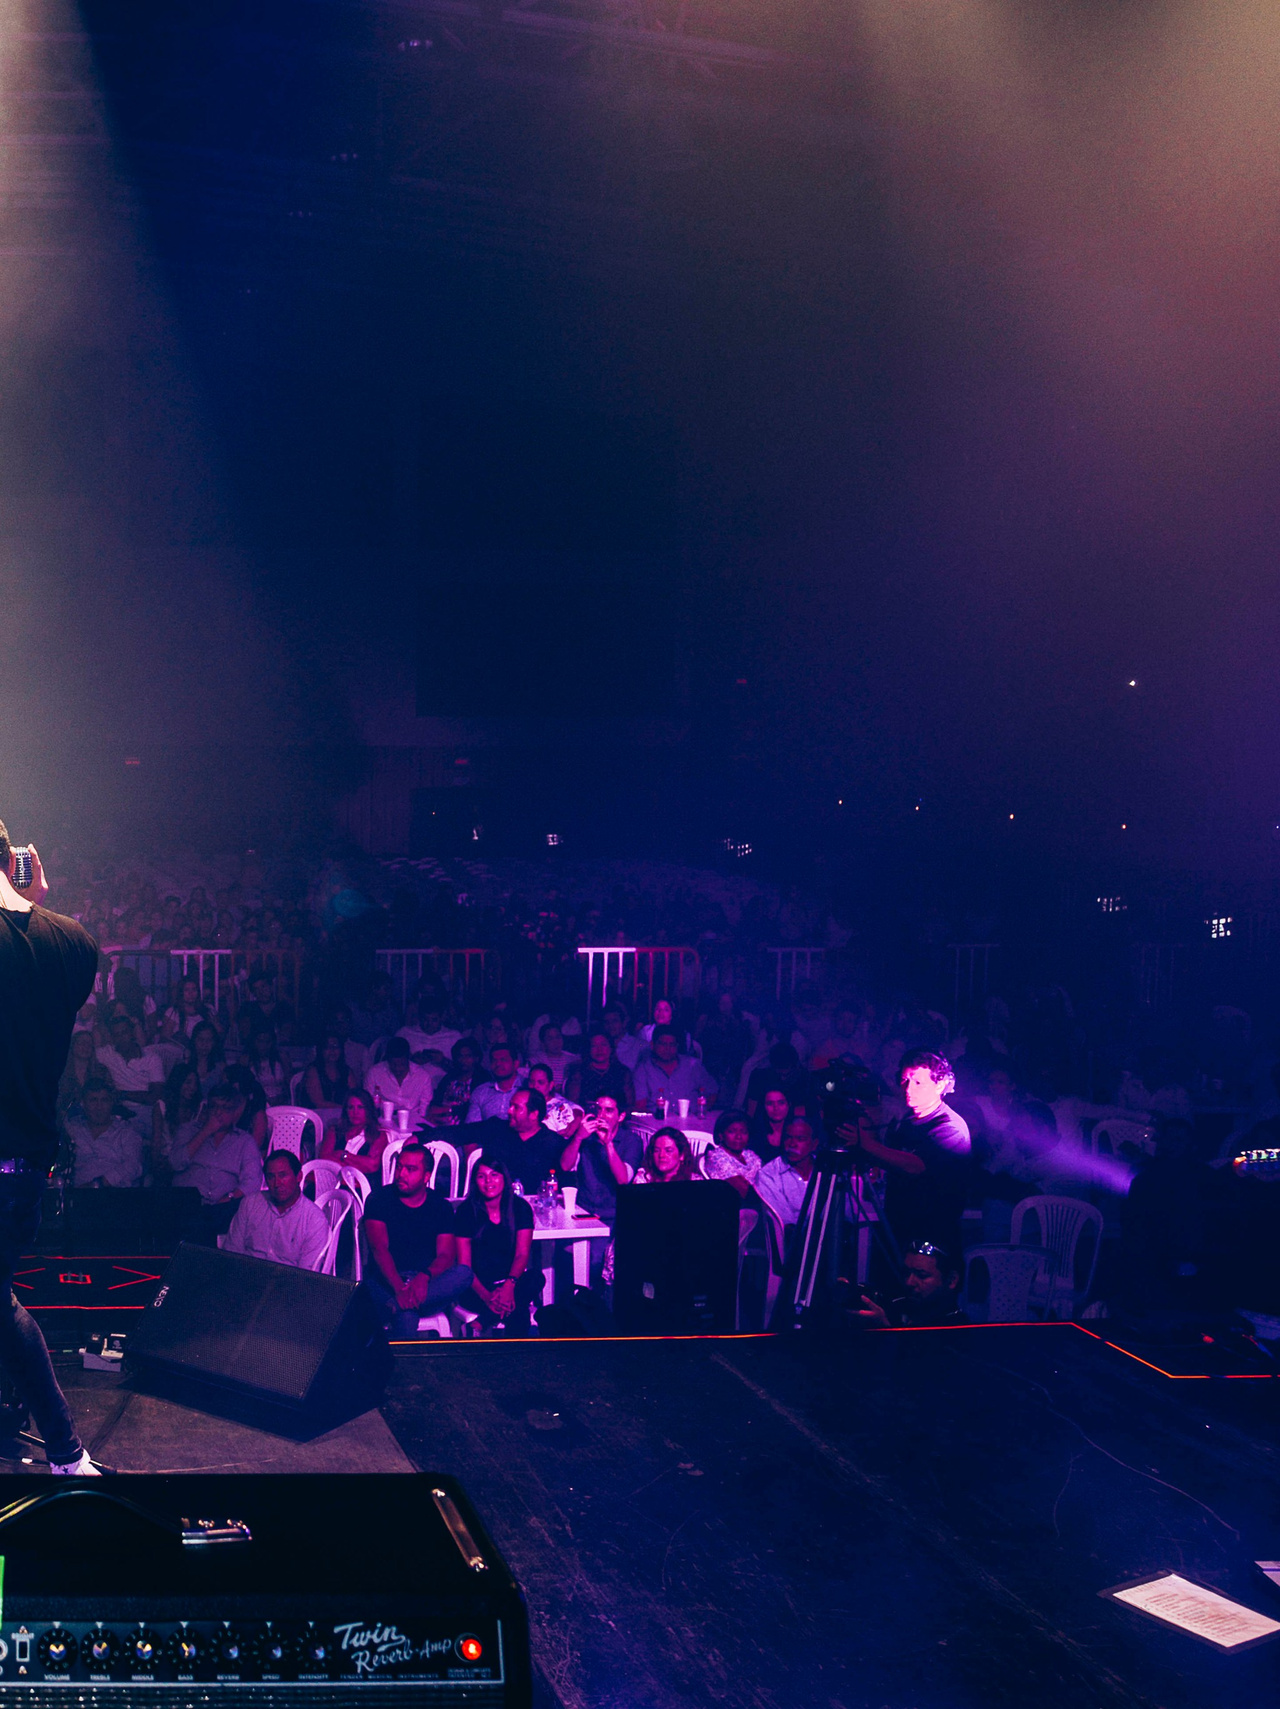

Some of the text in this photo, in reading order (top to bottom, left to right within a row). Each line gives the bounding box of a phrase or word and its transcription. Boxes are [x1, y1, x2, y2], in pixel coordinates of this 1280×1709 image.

[153, 1286, 170, 1308] NEXO
[333, 1621, 406, 1653] Twin
[44, 1673, 71, 1681] VOLUME
